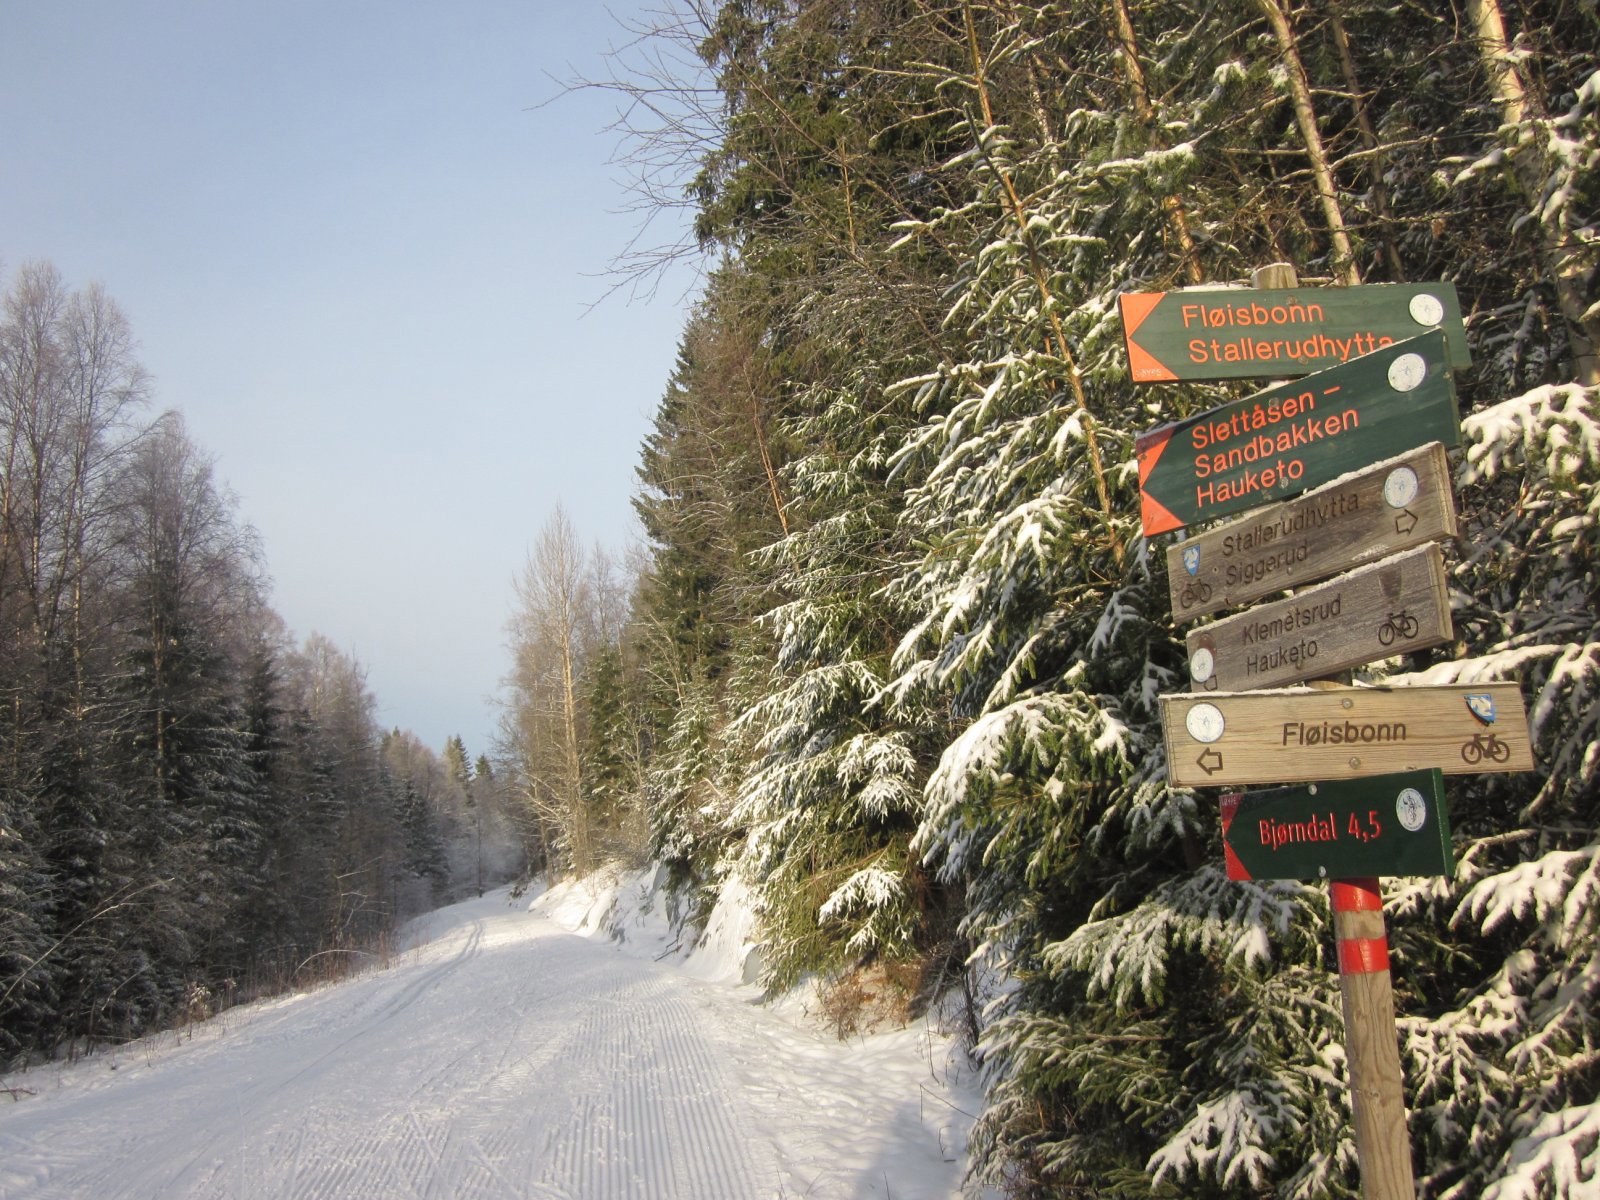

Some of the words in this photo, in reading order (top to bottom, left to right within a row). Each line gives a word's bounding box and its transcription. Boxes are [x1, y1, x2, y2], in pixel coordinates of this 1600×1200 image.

[1182, 303, 1324, 328] Fløisbonn
[1189, 331, 1394, 362] Stallerudhytta
[1192, 391, 1315, 449] Slettåsen
[1194, 407, 1360, 478] Sandbakken
[1196, 459, 1304, 508] Hauketo
[1222, 491, 1360, 557] Stallerudhytta
[1226, 541, 1308, 586] Siggerud
[1246, 639, 1318, 676] Hauketo
[1282, 720, 1407, 746] Fløisbonn
[1259, 812, 1338, 851] Bjørndal
[1347, 810, 1382, 843] 4,5
